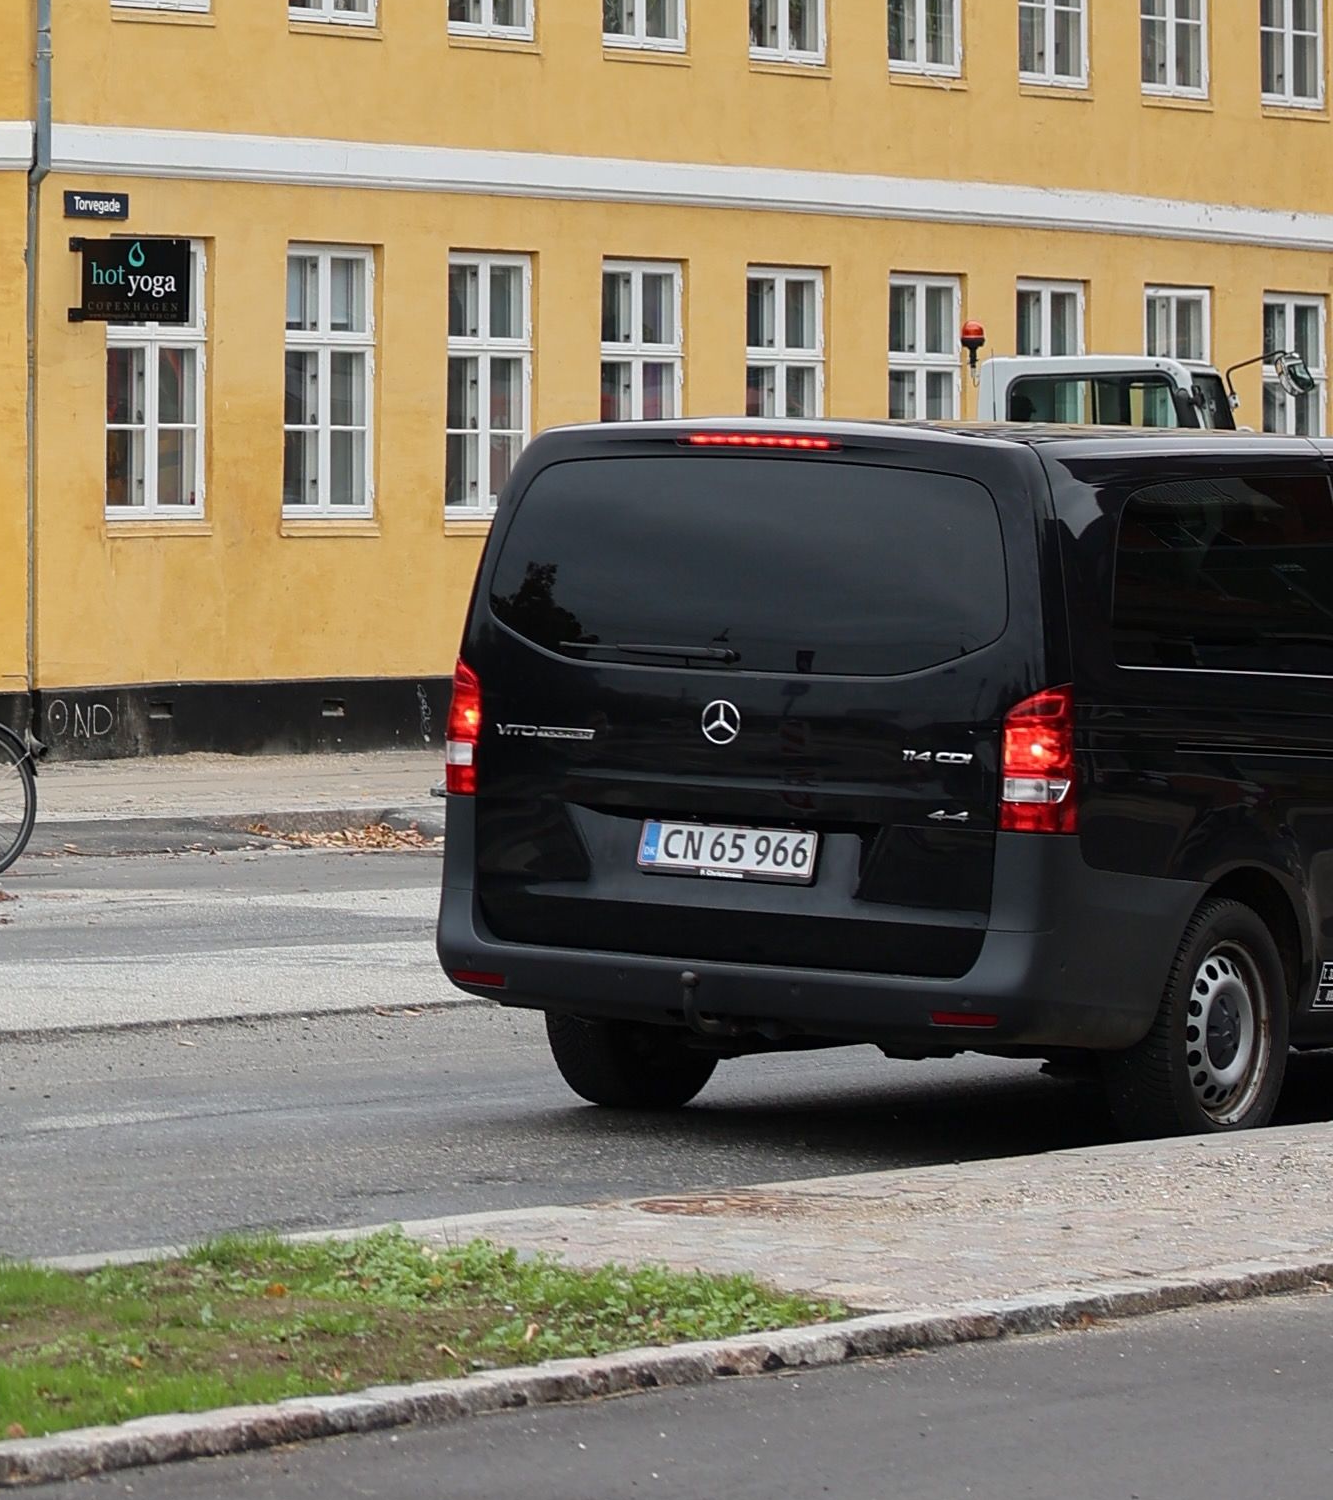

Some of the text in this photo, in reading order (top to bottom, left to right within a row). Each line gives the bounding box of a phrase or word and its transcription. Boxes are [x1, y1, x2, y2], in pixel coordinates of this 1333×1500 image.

[74, 196, 121, 214] Torvegade
[91, 262, 177, 298] hot yoga
[87, 300, 179, 312] COPENHAGEN
[496, 723, 538, 737] VITO
[902, 750, 973, 765] 114 CDI
[663, 829, 808, 868] CN 65 966
